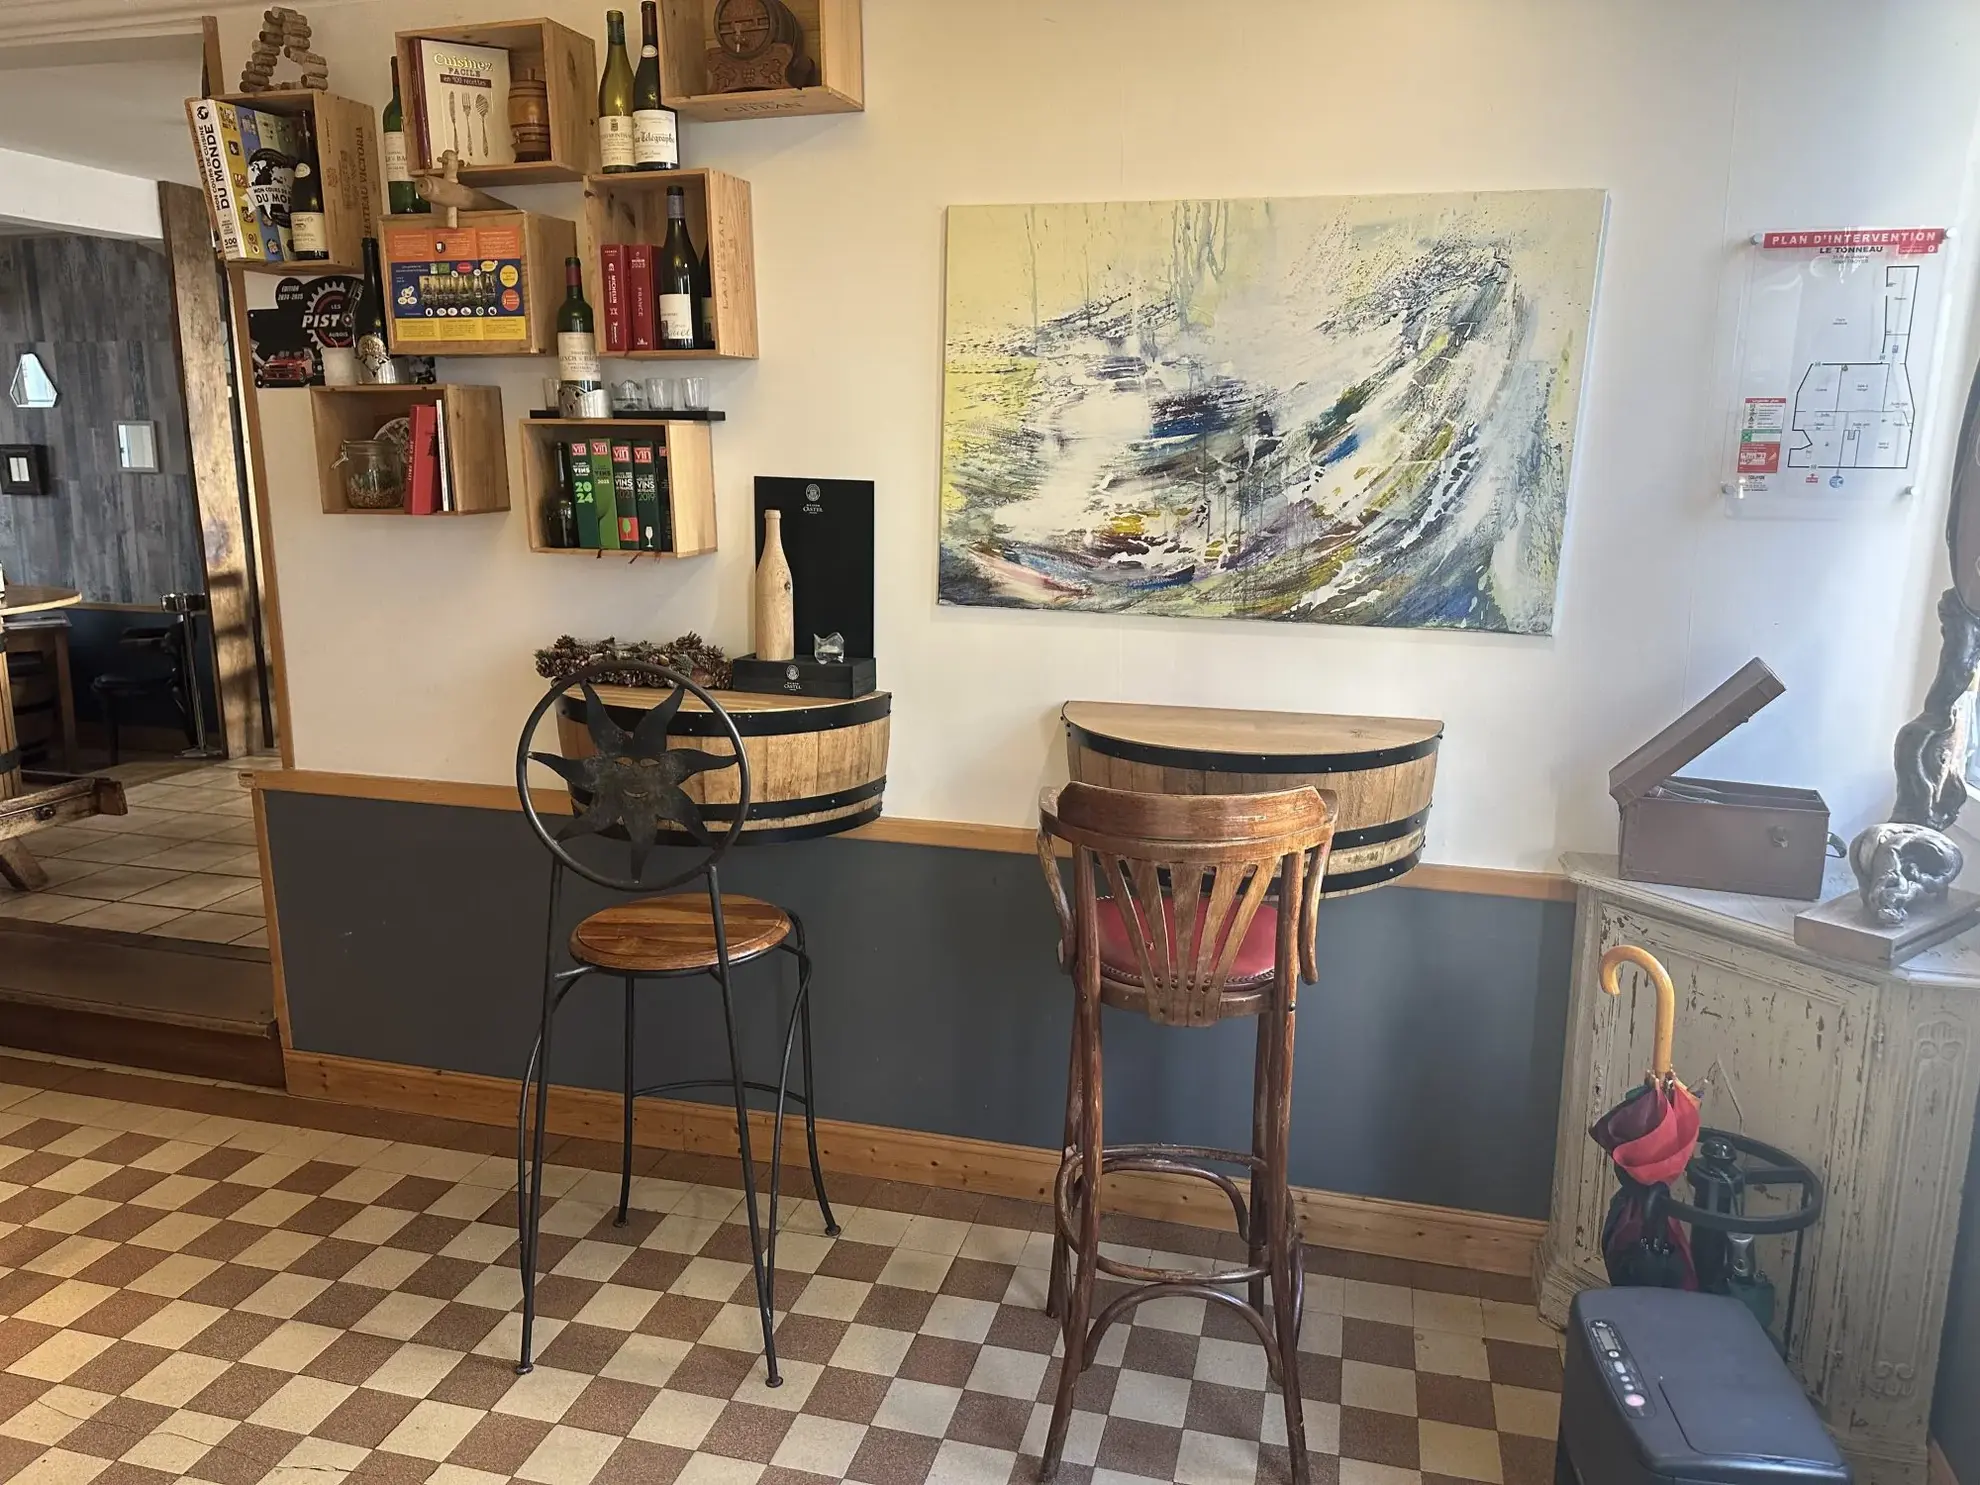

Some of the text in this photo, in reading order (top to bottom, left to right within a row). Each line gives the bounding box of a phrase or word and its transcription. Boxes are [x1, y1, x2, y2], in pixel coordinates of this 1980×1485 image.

[434, 53, 493, 72] Cuisinez
[203, 123, 225, 182] MONDE
[198, 125, 221, 211] MON COURS DE CUISINE
[217, 187, 230, 209] DU
[255, 194, 269, 203] DU
[1771, 231, 1937, 245] PLAN D'INTERVENTION
[1835, 246, 1884, 254] TONNEAU
[575, 481, 592, 492] 20
[616, 479, 633, 487] VINS
[637, 481, 655, 489] VINS
[577, 493, 593, 503] 24
